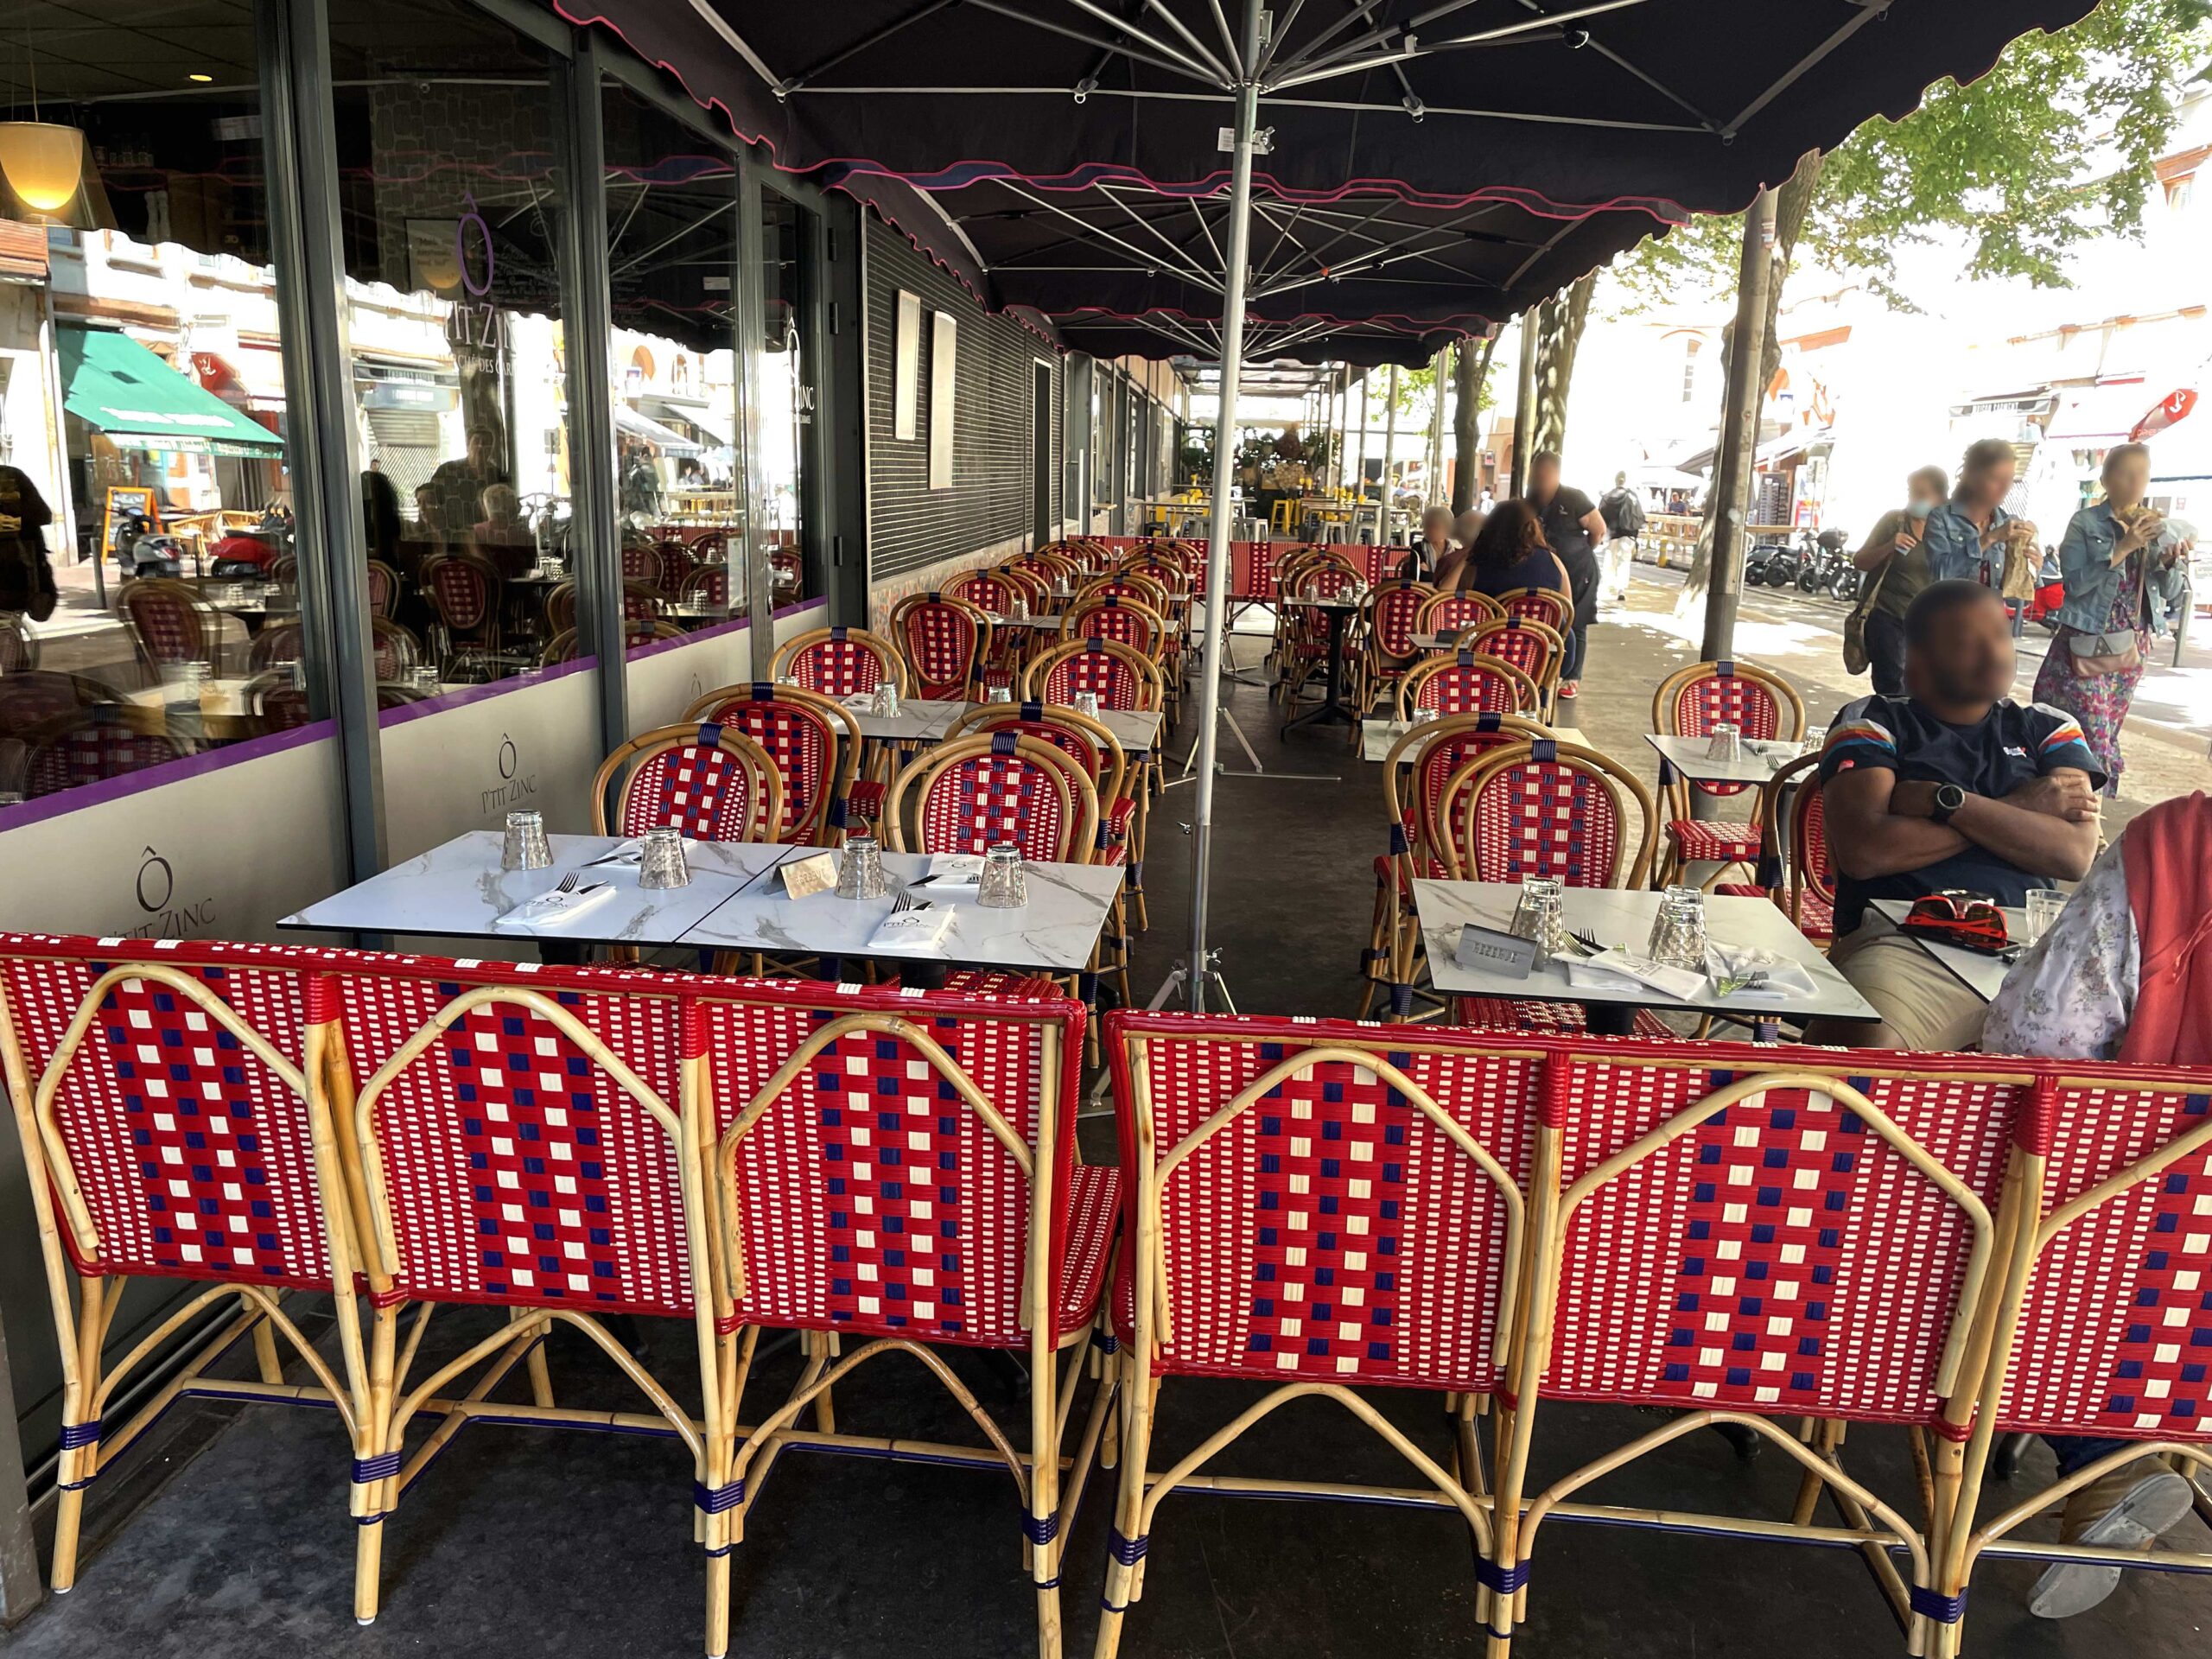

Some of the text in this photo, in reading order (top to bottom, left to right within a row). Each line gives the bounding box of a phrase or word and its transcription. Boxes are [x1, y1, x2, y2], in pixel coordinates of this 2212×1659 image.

[499, 732, 517, 779] Ô
[480, 774, 537, 814] P'TIT ZINC
[137, 845, 173, 912] Ô
[158, 897, 216, 939] ZINC
